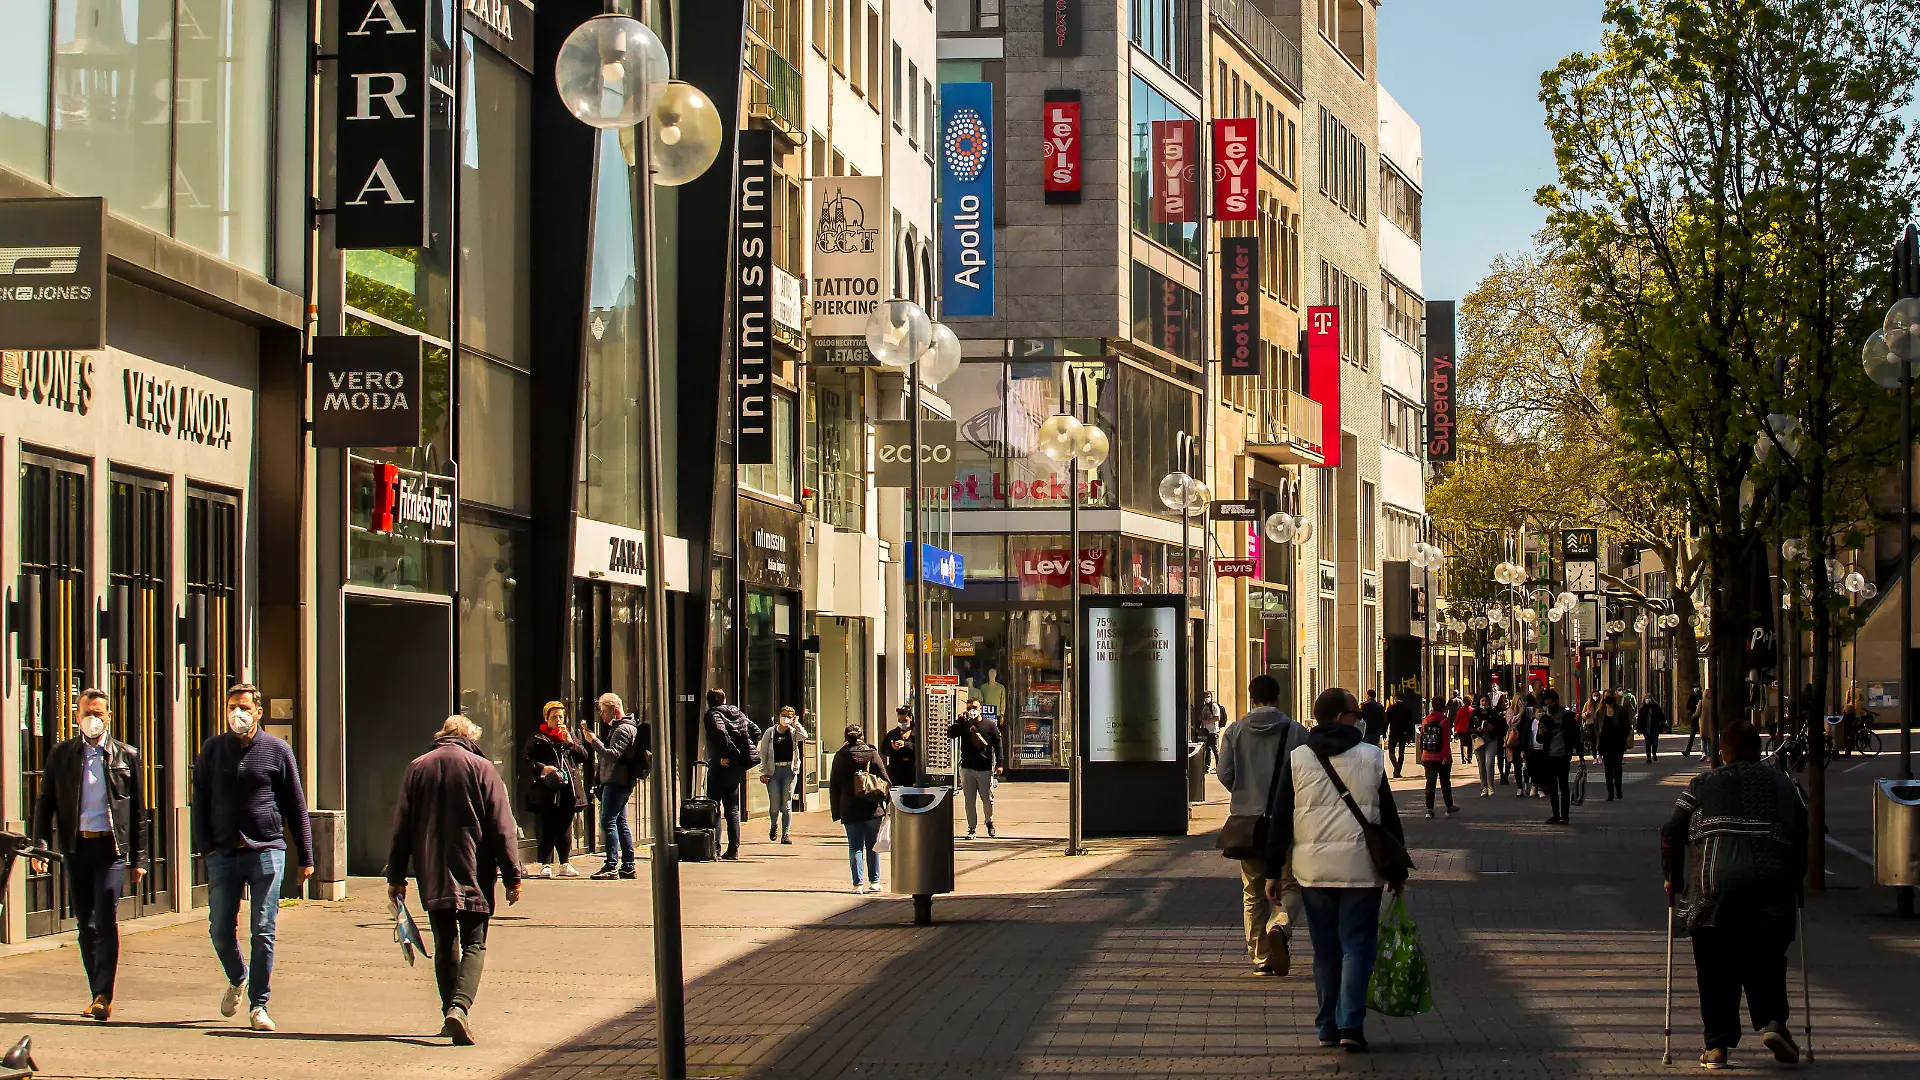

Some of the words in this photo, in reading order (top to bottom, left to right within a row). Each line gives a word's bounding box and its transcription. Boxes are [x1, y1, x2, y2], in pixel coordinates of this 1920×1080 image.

[954, 195, 986, 289] Apollo
[814, 278, 879, 296] TATTOO
[1231, 245, 1249, 315] Locker
[739, 159, 764, 434] intimissimi
[814, 300, 878, 315] PIERCING
[826, 349, 869, 362] 1.ETAGE
[1231, 322, 1249, 367] Foot
[328, 371, 404, 389] VERO
[122, 368, 177, 432] VERO
[178, 386, 232, 446] MODA
[323, 392, 409, 411] MODA
[1429, 355, 1453, 456] Superdry.
[879, 444, 951, 463] ecco
[993, 472, 1104, 499] Locker
[609, 536, 646, 575] ZARA
[1024, 558, 1096, 575] Lev's
[1096, 652, 1106, 661] IN
